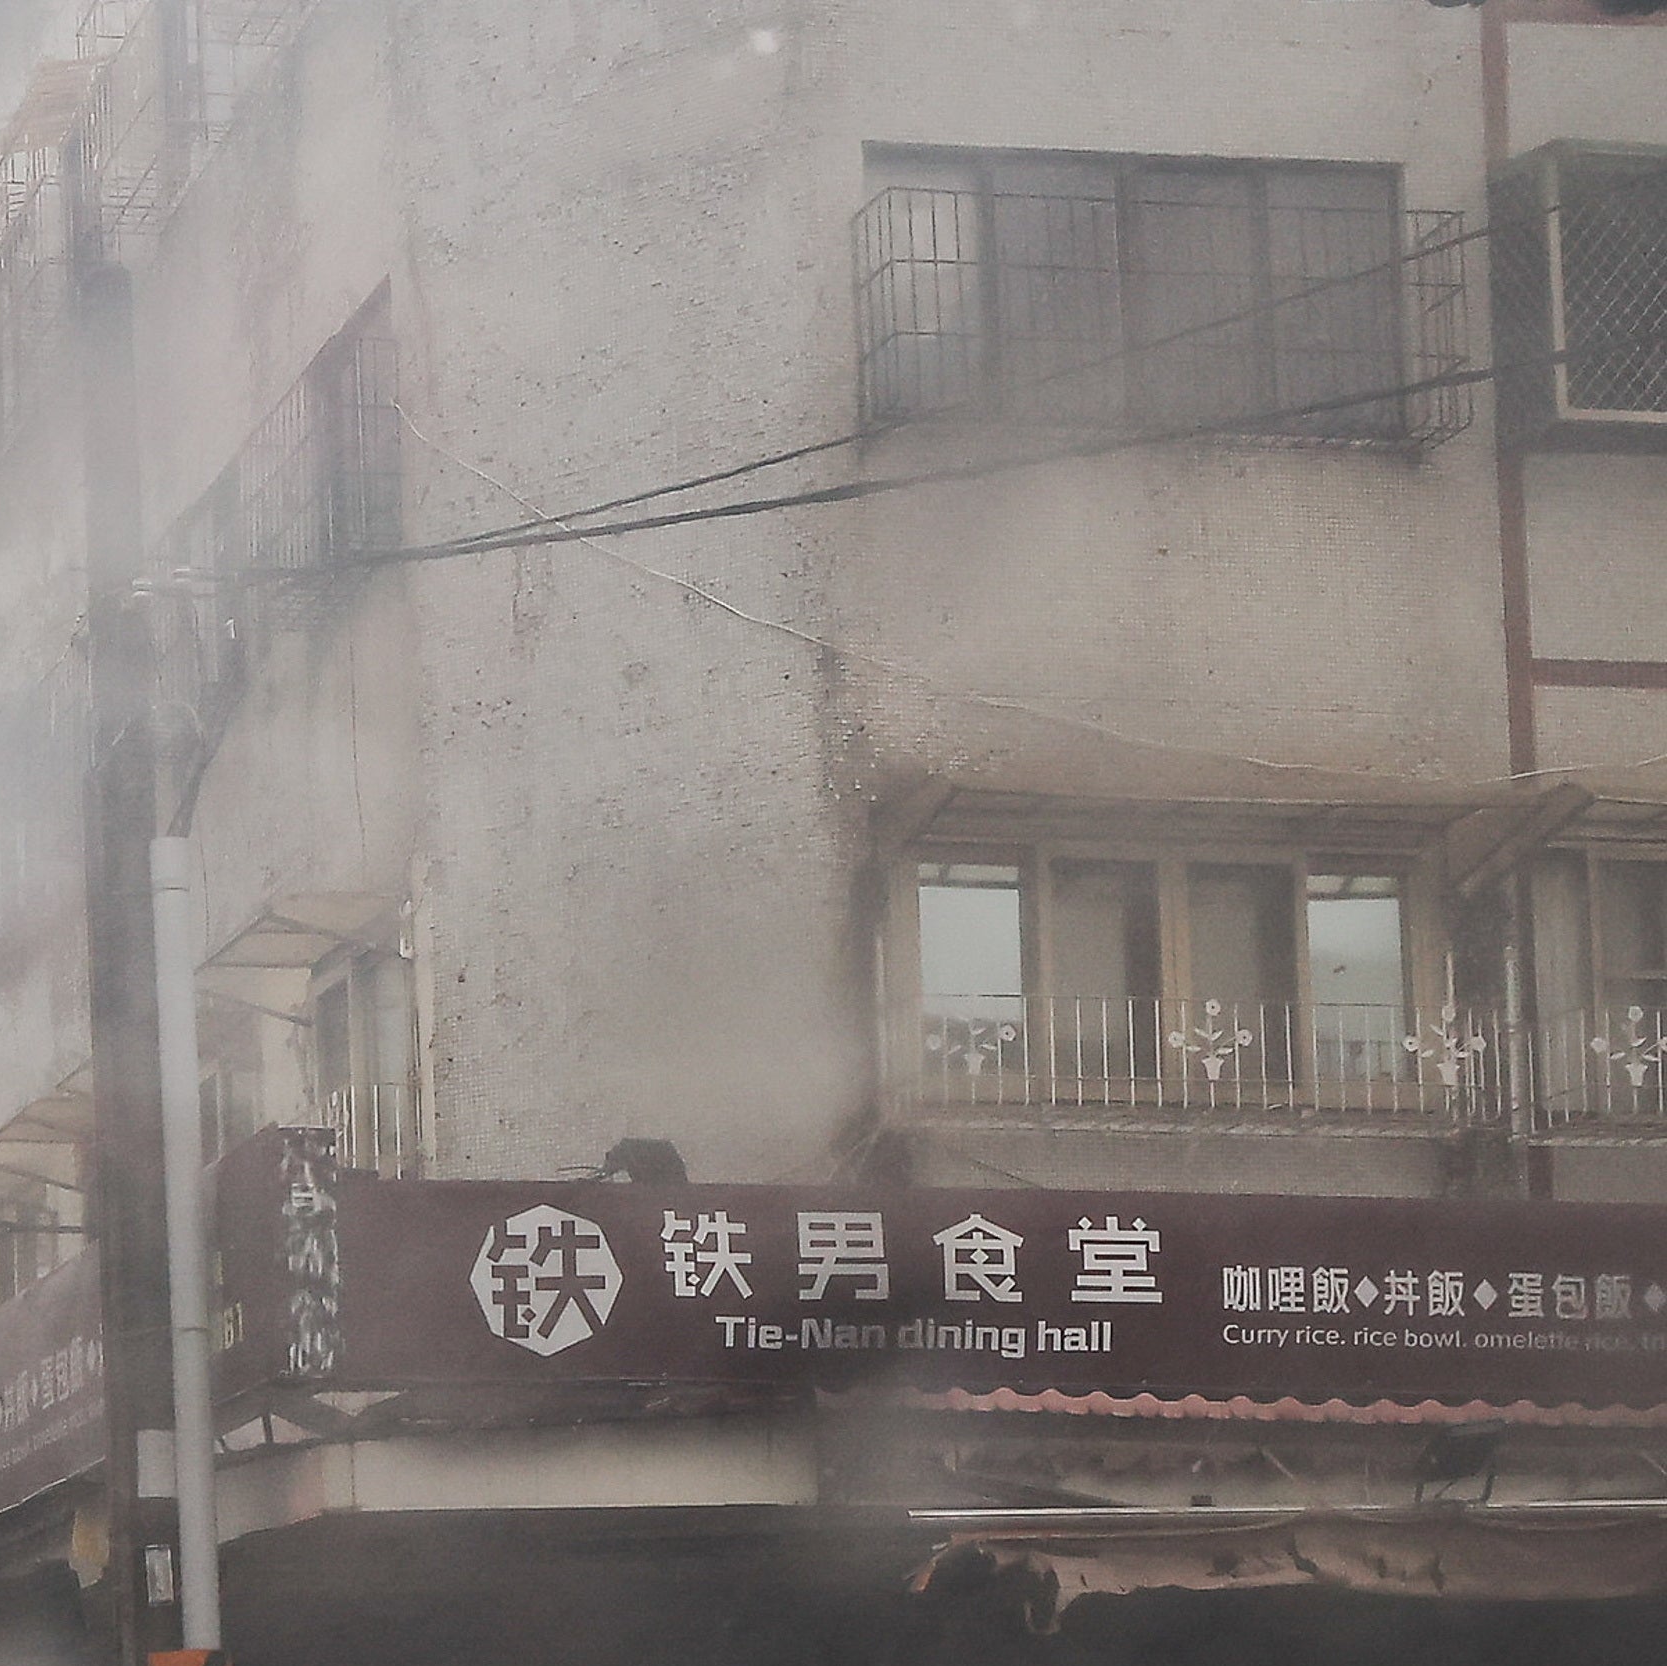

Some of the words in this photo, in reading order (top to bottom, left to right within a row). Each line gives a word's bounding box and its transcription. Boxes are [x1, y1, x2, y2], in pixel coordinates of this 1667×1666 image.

[475, 1210, 617, 1352] 铁
[660, 1210, 1163, 1303] 铁男食堂
[1222, 1265, 1351, 1315] 咖哩飯
[1508, 1272, 1633, 1320] 蛋包飯
[714, 1315, 886, 1351] Tie-Nan
[897, 1318, 1026, 1359] dining
[1037, 1320, 1112, 1353] hall
[1222, 1323, 1290, 1348] Curry
[1353, 1327, 1398, 1348] rice
